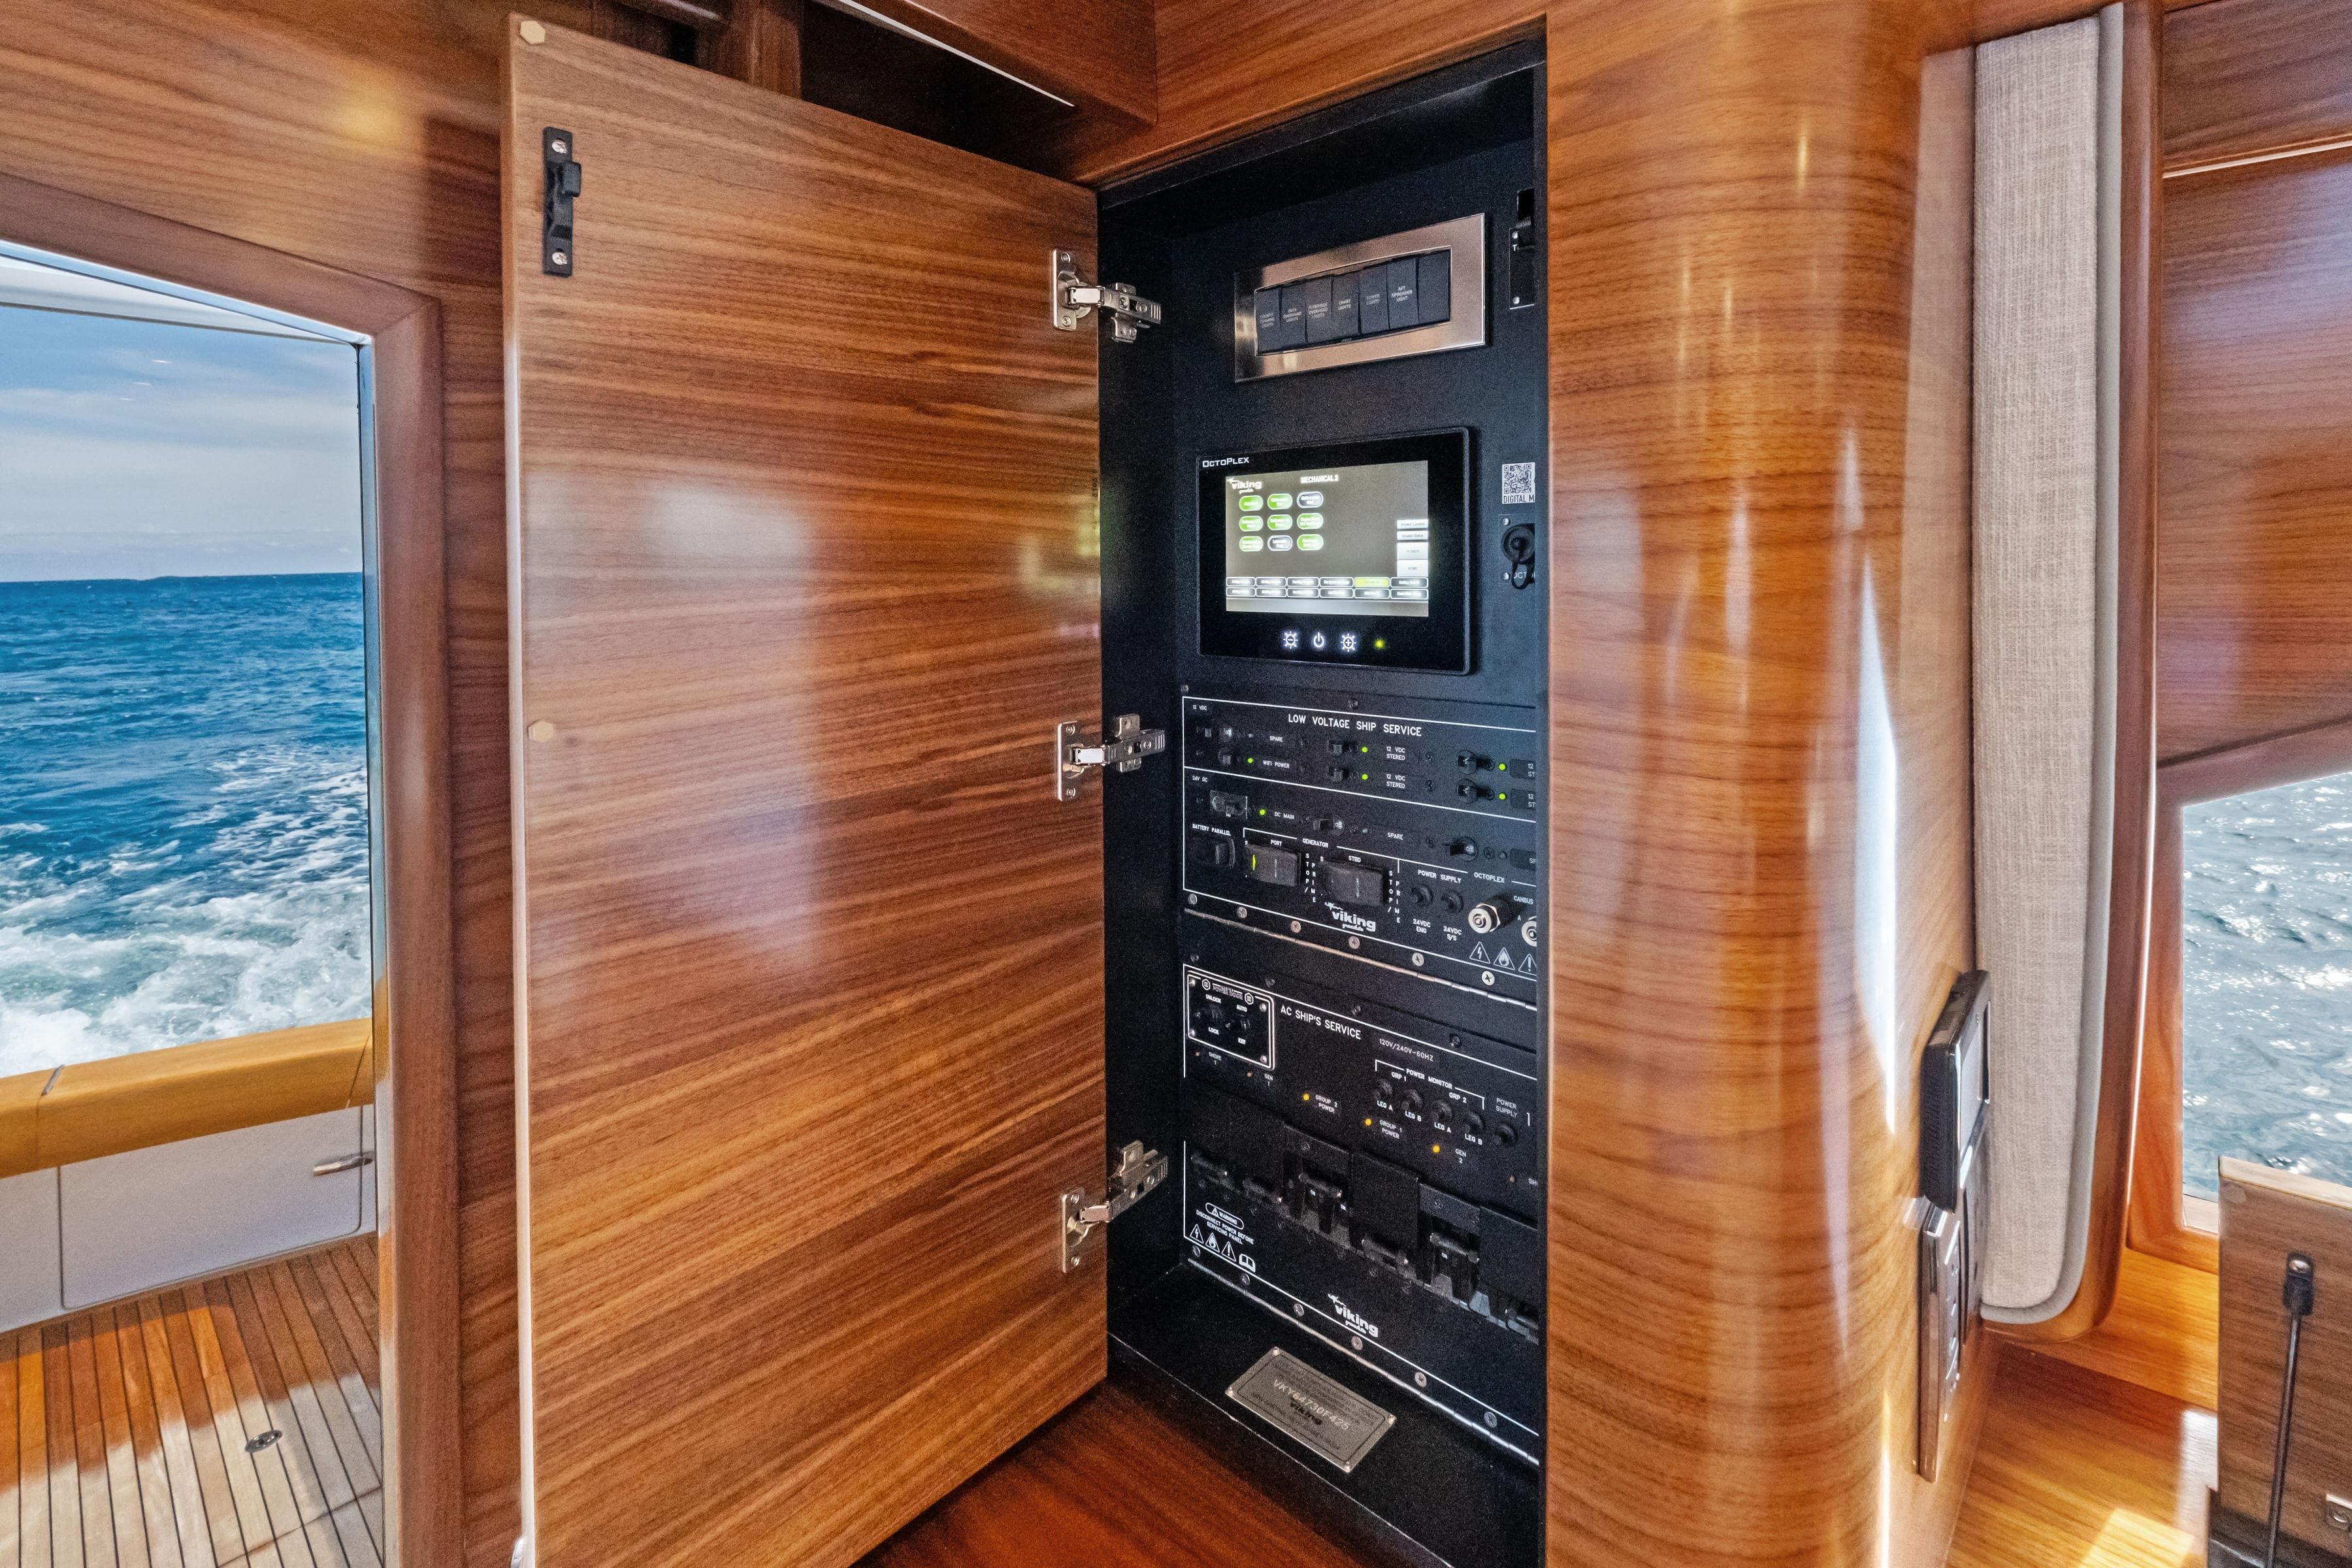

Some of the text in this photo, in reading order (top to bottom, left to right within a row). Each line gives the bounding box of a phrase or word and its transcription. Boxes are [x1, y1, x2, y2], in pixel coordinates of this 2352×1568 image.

[1503, 495, 1527, 504] DIGITAL
[1288, 713, 1422, 736] LOW VOLTAGE SHIP SERVICE
[1211, 827, 1231, 836] PARALLEL
[1302, 838, 1329, 848] GENERATOR
[1418, 870, 1462, 884] POWER SUPPLY
[1474, 872, 1505, 883] OCTOPLEX
[1513, 895, 1534, 904] CANBUS
[1331, 911, 1376, 932] viking
[1413, 918, 1431, 928] 24VDC
[1443, 926, 1462, 935] 24VDC
[1205, 994, 1221, 1004] UNLOCK
[1236, 1004, 1247, 1013] AUTO
[1281, 1005, 1361, 1039] AC SHIP'S SERVICE
[1379, 1038, 1433, 1062] 120V/240V-60HZ
[1406, 1068, 1453, 1089] POWER MONITOR
[1316, 1094, 1331, 1103] GROUP
[1496, 1098, 1517, 1109] POWER
[1318, 1103, 1335, 1113] POWER
[1495, 1105, 1518, 1118] SUPPLY
[1405, 1111, 1415, 1119] LEG
[1379, 1120, 1396, 1130] GROUP
[1434, 1122, 1445, 1130] LEG
[1382, 1128, 1399, 1139] POWER
[1465, 1133, 1476, 1143] LEG
[1456, 1149, 1467, 1157] GEN
[1196, 1209, 1220, 1226] DISCONNECT
[1222, 1223, 1237, 1235] POWER
[1219, 1211, 1237, 1225] WARNING
[1207, 1221, 1243, 1245] SERVICING PANEL
[1335, 1305, 1379, 1338] viking
